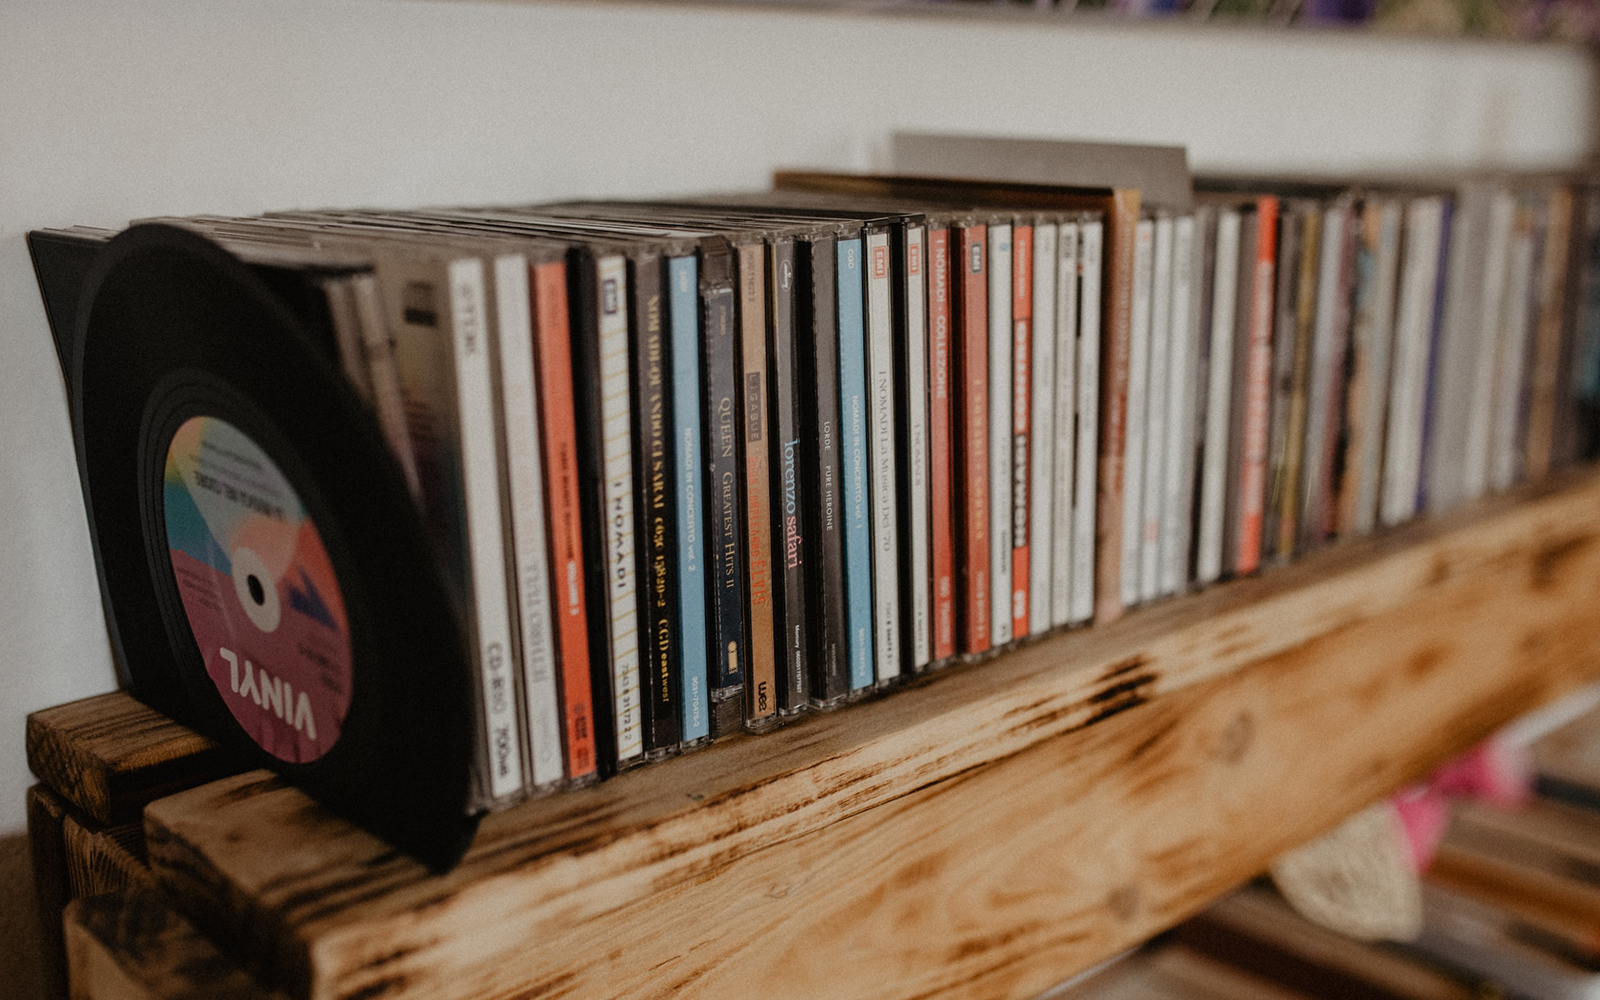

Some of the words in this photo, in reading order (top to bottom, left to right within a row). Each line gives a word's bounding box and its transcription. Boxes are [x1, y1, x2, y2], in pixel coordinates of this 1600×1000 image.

[935, 247, 944, 301] NOMADI
[972, 245, 980, 271] EMI
[935, 315, 945, 399] COLLEZIONE
[717, 396, 732, 458] QUEEN
[747, 374, 760, 440] LIGABUE
[851, 394, 859, 434] NOMADI
[878, 376, 887, 436] NOMADI
[683, 427, 693, 470] NOMADI
[853, 436, 859, 446] IN
[651, 460, 664, 508] SARAI
[685, 471, 694, 482] IN
[784, 438, 801, 515] lorenzo
[853, 447, 861, 502] CONCERTO
[880, 457, 890, 504] Musica
[685, 483, 695, 543] CONCERTO
[721, 471, 734, 538] GREATEST
[613, 496, 627, 590] NOMADI
[724, 542, 735, 576] HITS
[786, 513, 802, 570] safari
[725, 578, 734, 588] II
[750, 558, 766, 606] ELVIS
[220, 646, 316, 740] VINYL
[757, 680, 767, 712] wea
